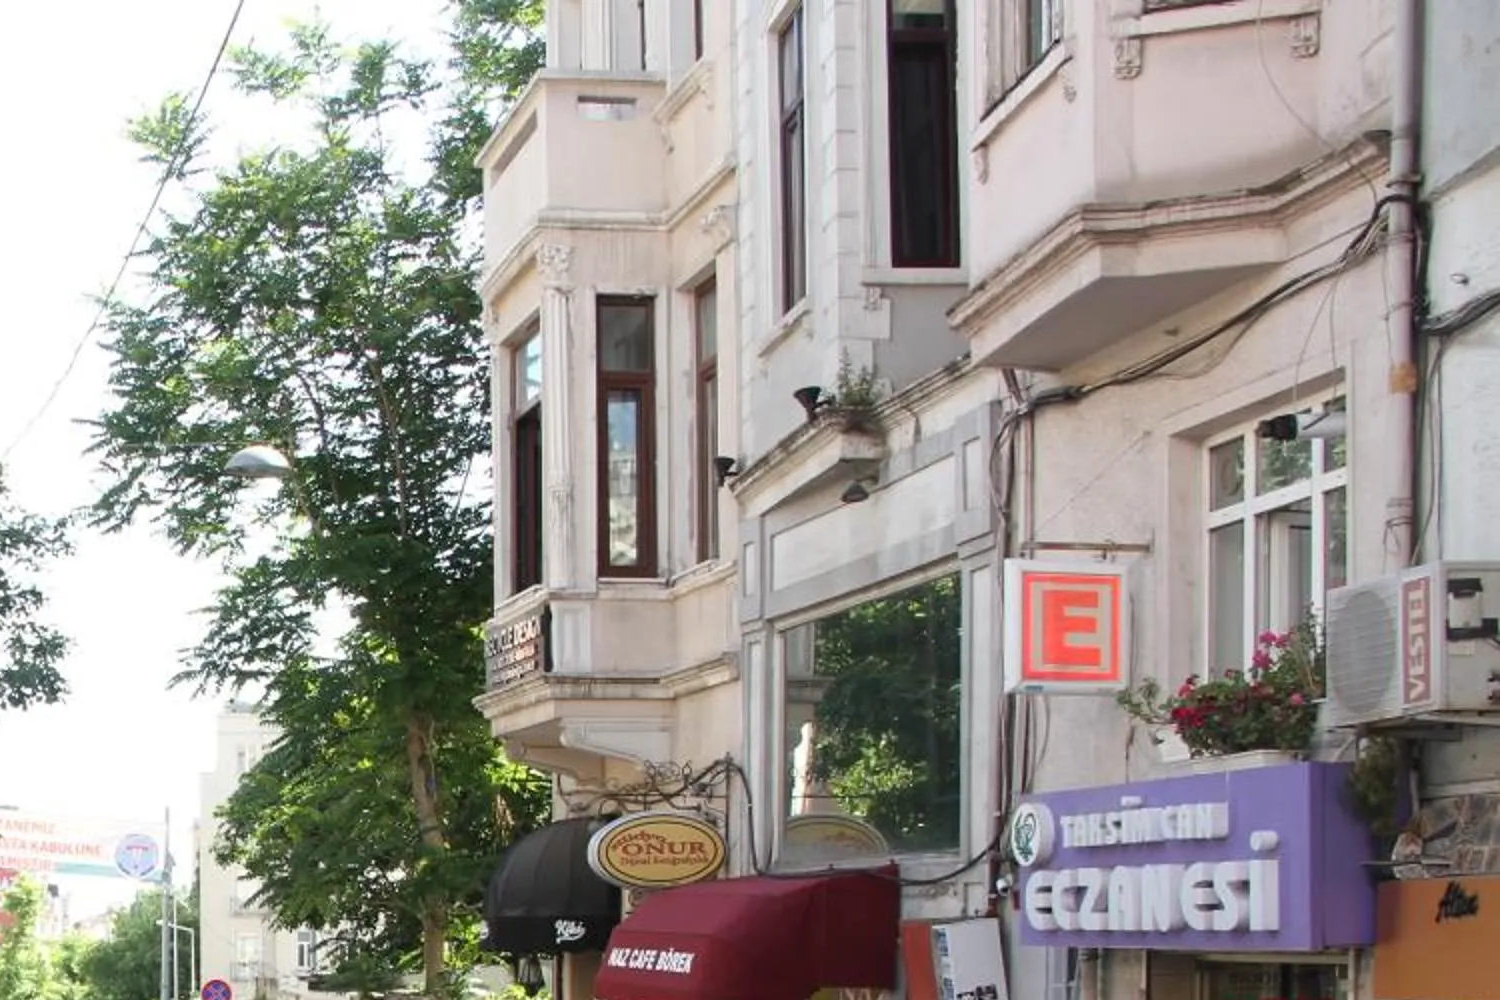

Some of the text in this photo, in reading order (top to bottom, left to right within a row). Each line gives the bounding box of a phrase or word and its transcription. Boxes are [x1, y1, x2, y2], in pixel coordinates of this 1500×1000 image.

[1042, 589, 1100, 666] E
[1407, 578, 1426, 701] VESTEL
[621, 841, 705, 856] ONUR
[1060, 796, 1228, 848] TAKSİM CAN
[1025, 830, 1280, 932] ECZANESİ
[607, 946, 696, 974] NAZ CAFE BÖREK
